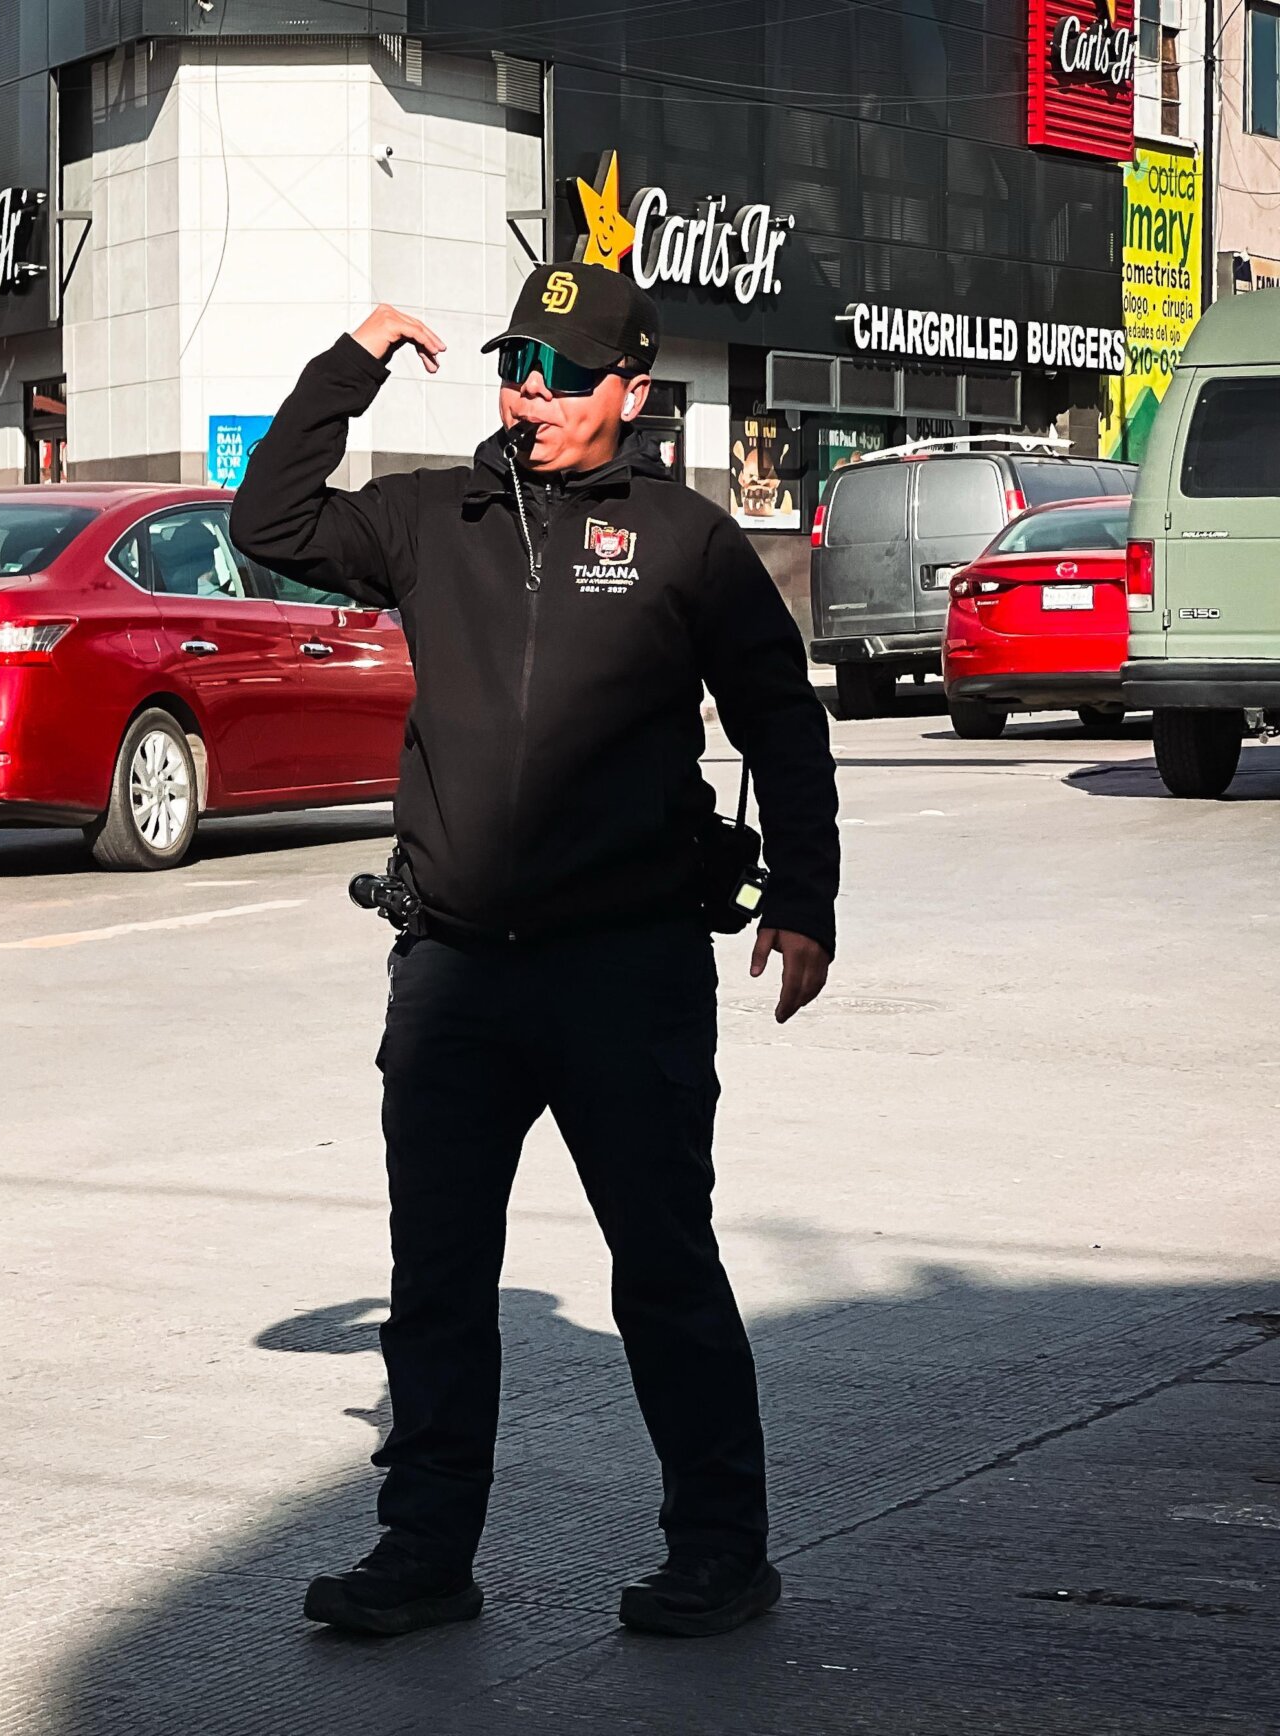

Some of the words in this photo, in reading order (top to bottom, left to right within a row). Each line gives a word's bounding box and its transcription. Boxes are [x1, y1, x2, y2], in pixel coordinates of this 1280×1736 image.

[1060, 15, 1111, 74] Carl's
[632, 187, 733, 290] Carl's
[735, 204, 786, 304] Jr.
[542, 271, 579, 314] SD
[854, 303, 1018, 361] CHARGRILLED
[1027, 311, 1125, 371] BURGERS
[572, 564, 640, 581] TIJUANA
[580, 585, 600, 593] 2024
[607, 586, 628, 594] 2027
